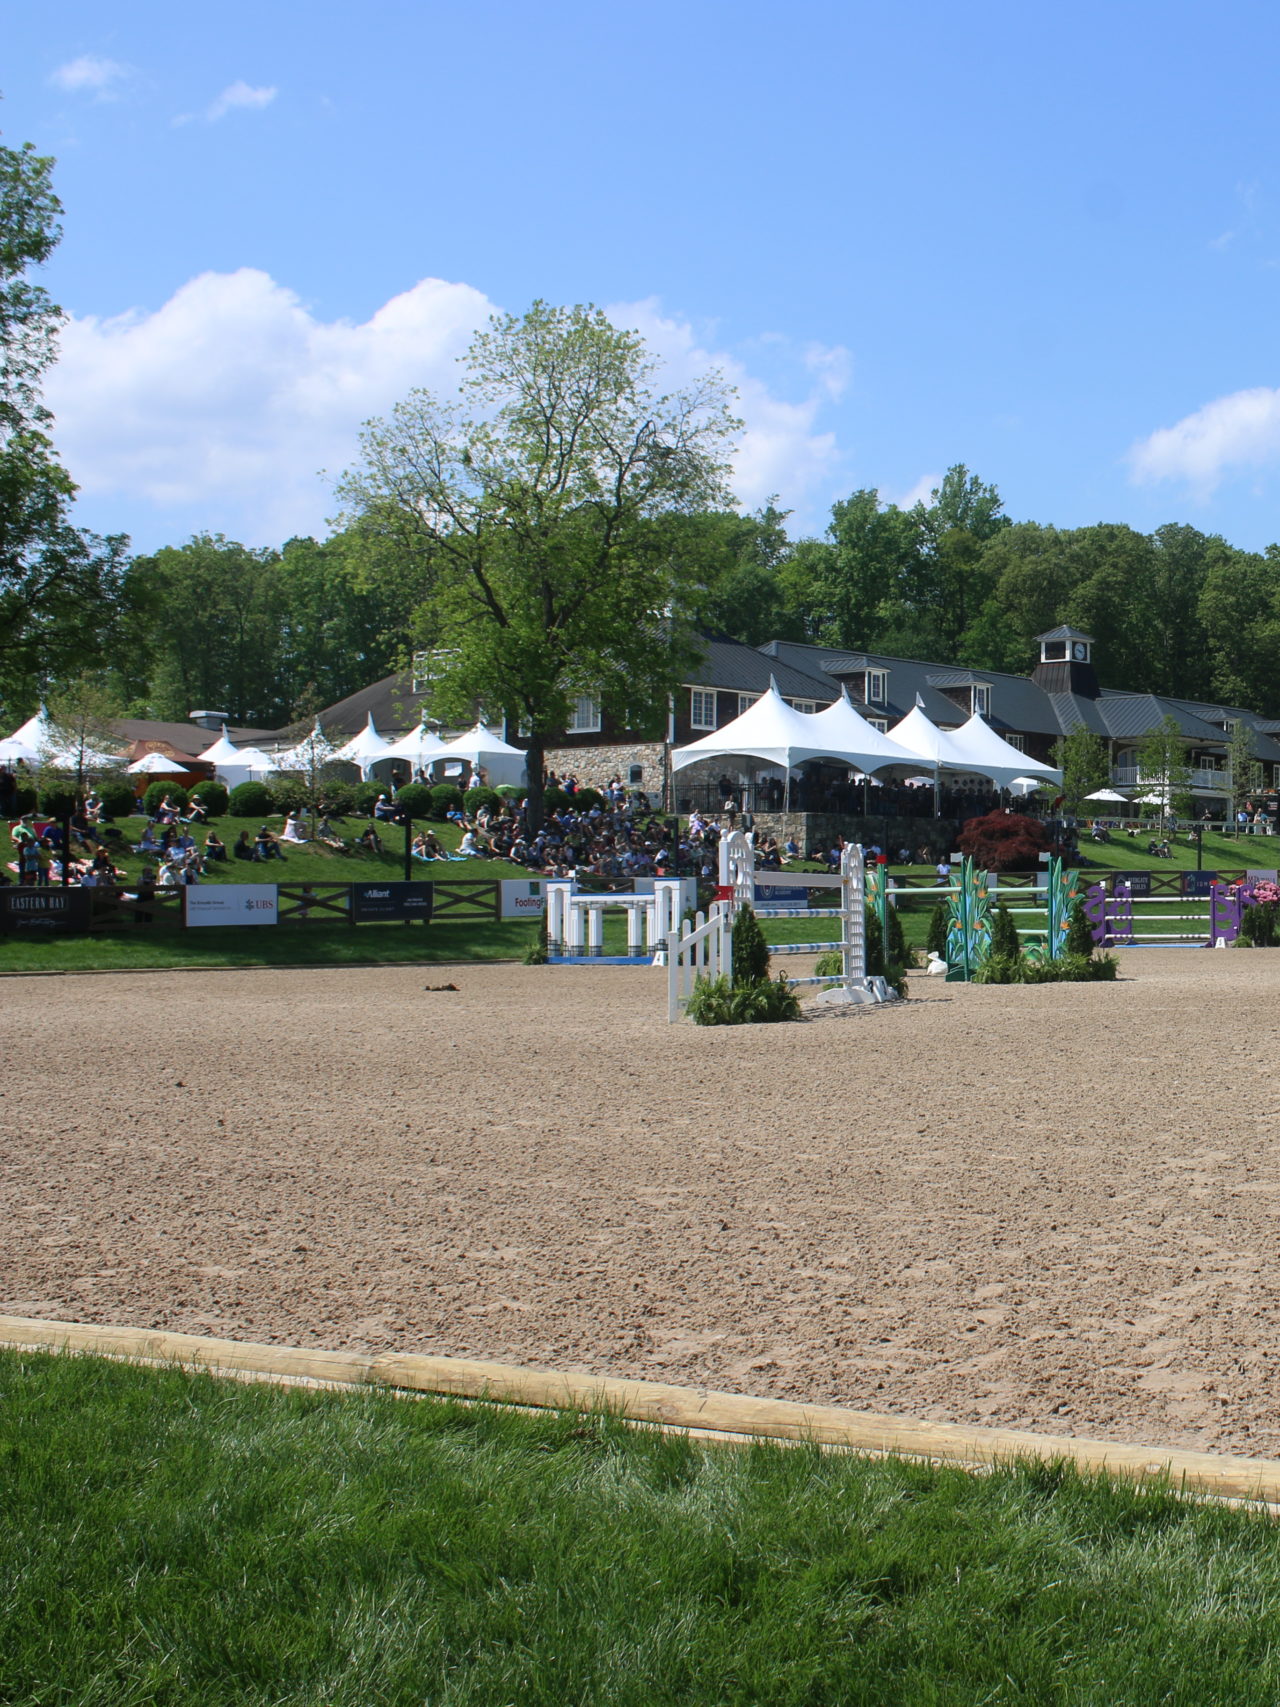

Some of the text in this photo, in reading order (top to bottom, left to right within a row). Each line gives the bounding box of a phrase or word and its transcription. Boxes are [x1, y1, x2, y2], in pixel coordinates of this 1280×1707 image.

[366, 889, 391, 898] Alliant
[11, 897, 46, 910] EASTERN
[255, 899, 274, 910] UBS
[515, 897, 545, 909] FootingF
